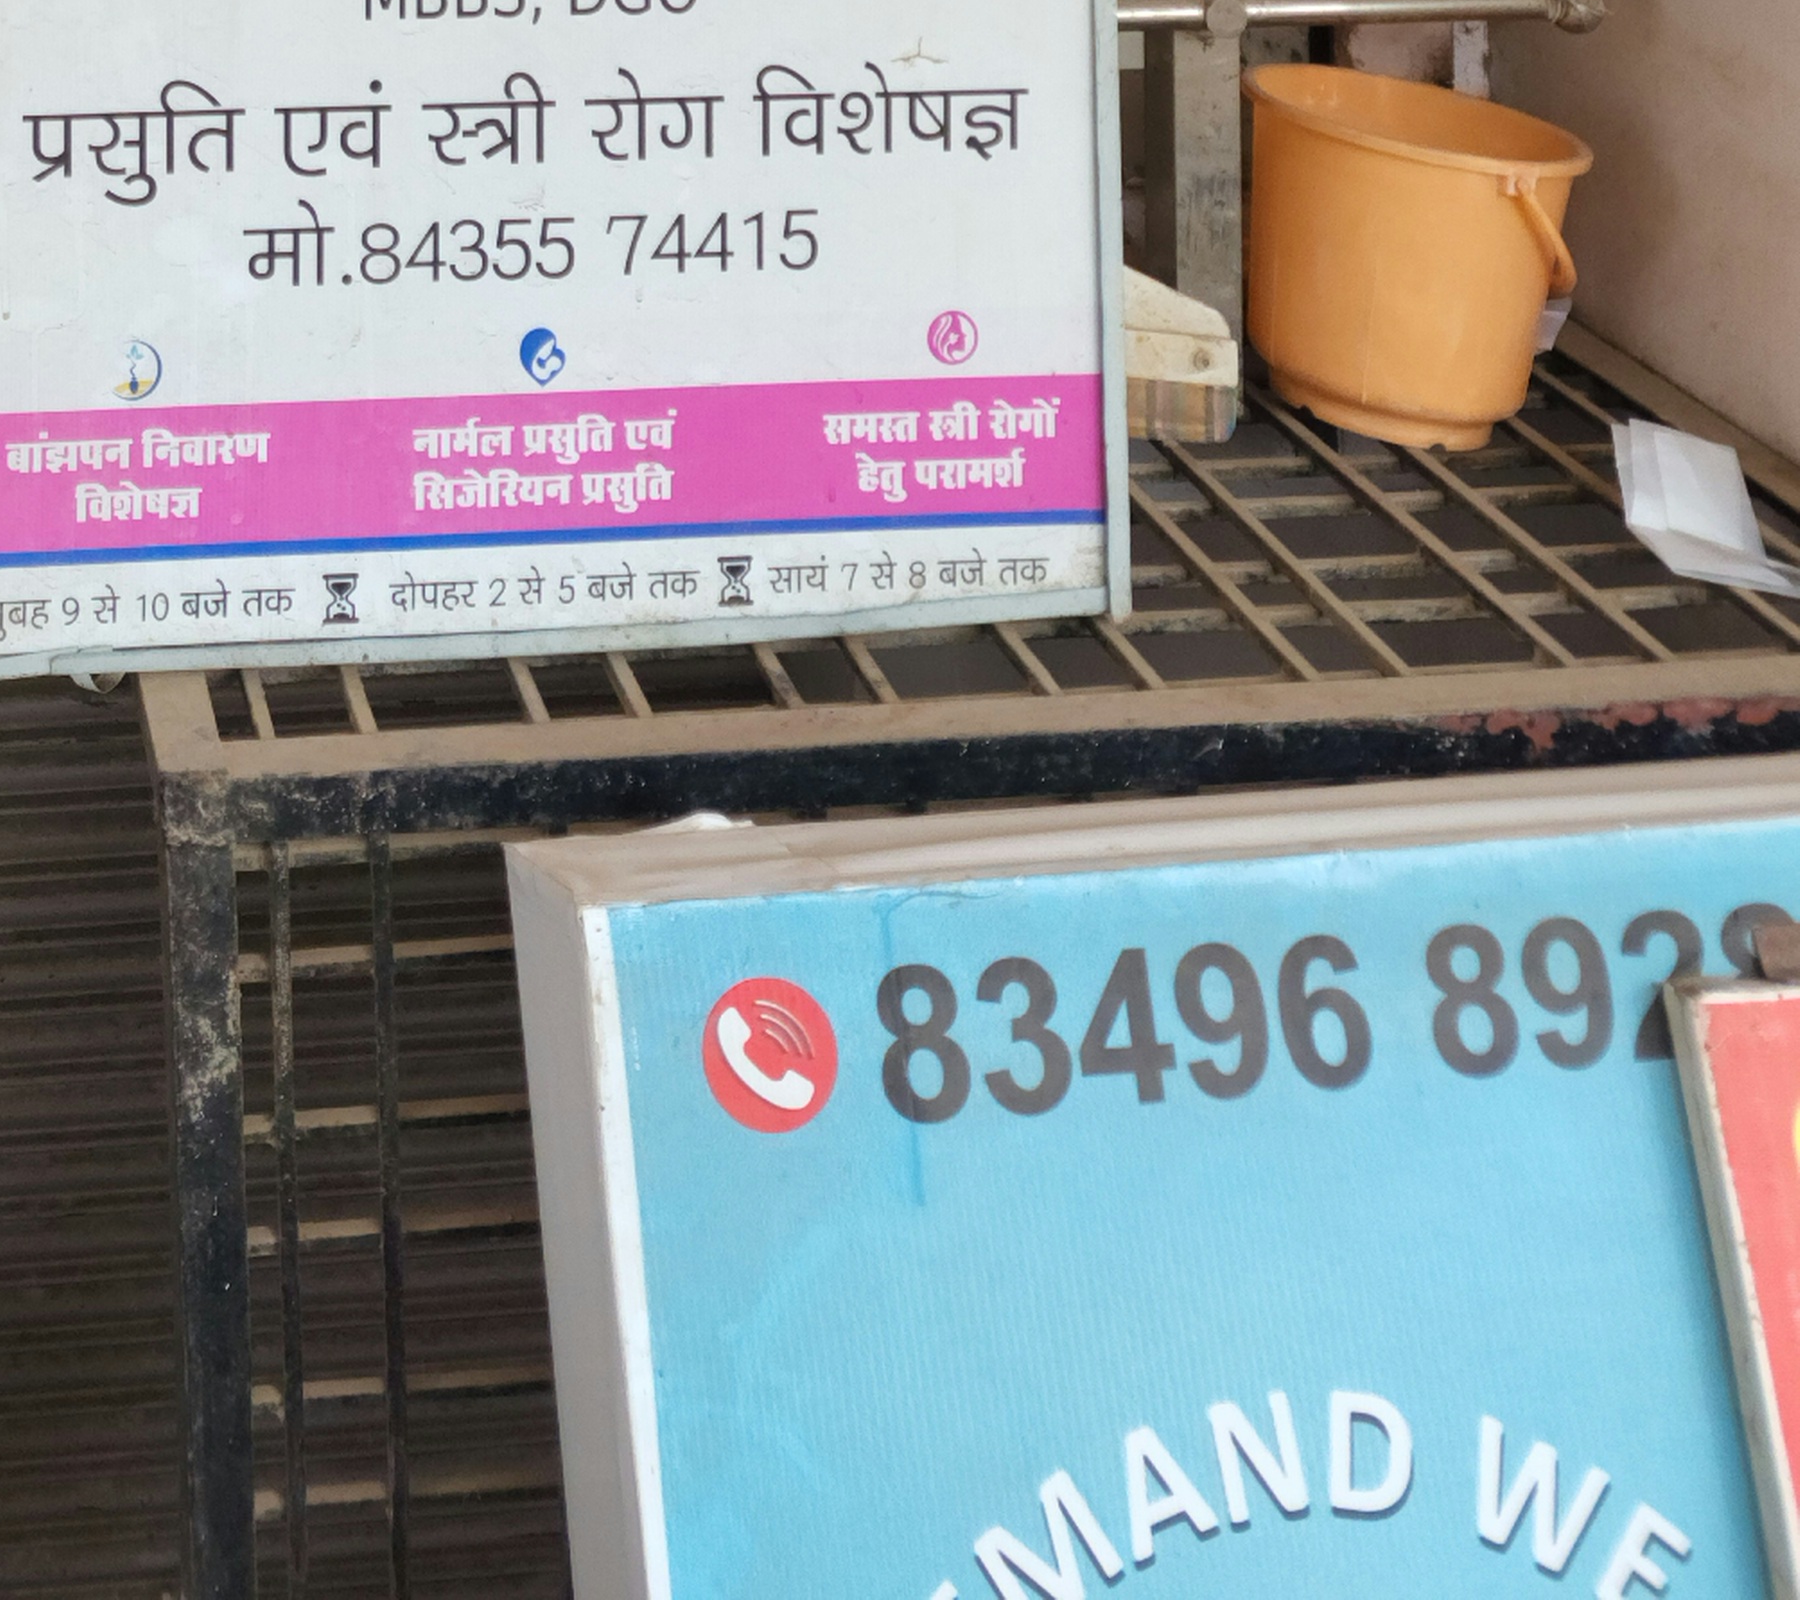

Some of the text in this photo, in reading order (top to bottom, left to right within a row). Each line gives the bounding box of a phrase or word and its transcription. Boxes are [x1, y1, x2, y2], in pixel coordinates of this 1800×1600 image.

[24, 60, 1029, 206] प्रसुति एवं स्त्री रोग विशेषज्ञ
[606, 208, 819, 275] 74415
[6, 429, 270, 474] बांझपन निवारण
[412, 408, 677, 465] नार्मल प्रसुति एवं
[823, 398, 1061, 445] समस्त स्त्री रोगों
[413, 462, 675, 513] सिजेरियन प्रसुति
[855, 447, 1027, 502] हेतु परामर्श
[61, 597, 80, 626] 9
[92, 584, 120, 624] से
[136, 594, 169, 621] 10
[181, 578, 230, 620] बजे
[242, 586, 296, 618] तक
[390, 572, 479, 612] दोपहर
[488, 579, 507, 608] 2
[517, 565, 545, 605] से
[558, 576, 576, 601] 5
[587, 561, 638, 601] बजे
[648, 568, 699, 598] तक
[768, 556, 829, 595] सायं
[842, 564, 858, 591] 7
[870, 551, 897, 590] से
[909, 560, 926, 590] 8
[938, 548, 987, 586] बजे
[998, 557, 1049, 586] तक
[875, 935, 1373, 1125] 83496
[930, 1389, 1413, 1600] MAND
